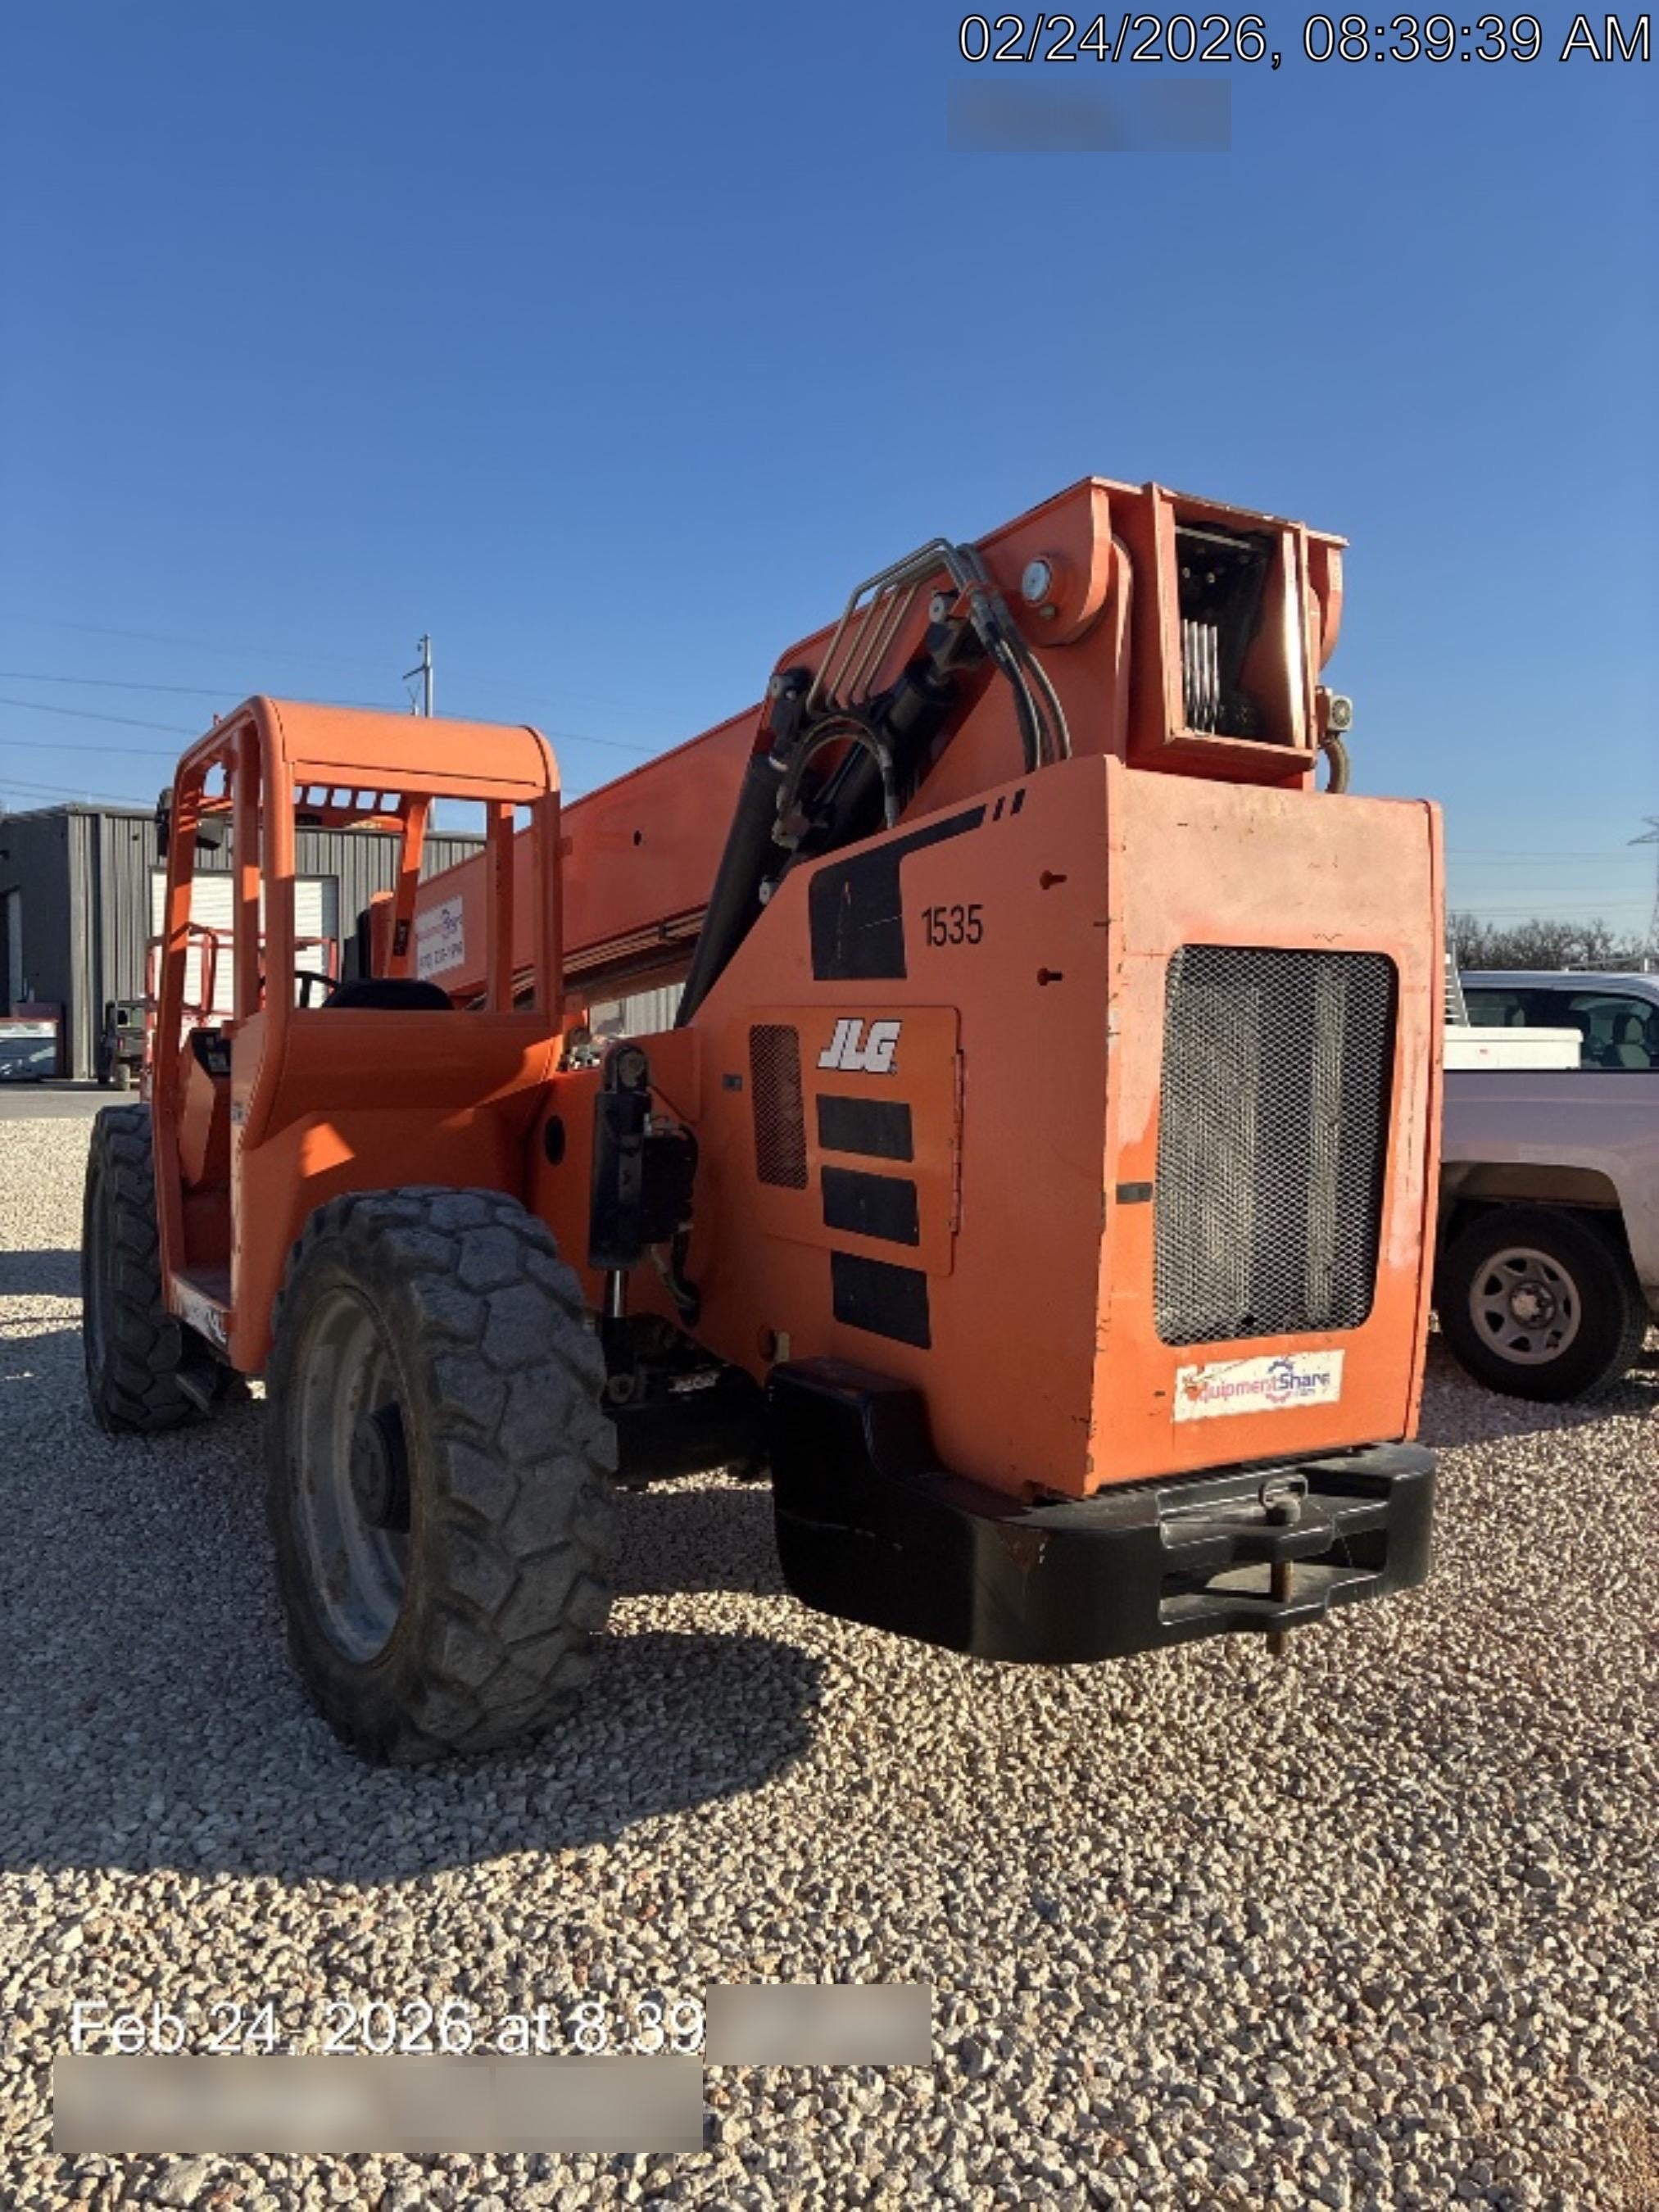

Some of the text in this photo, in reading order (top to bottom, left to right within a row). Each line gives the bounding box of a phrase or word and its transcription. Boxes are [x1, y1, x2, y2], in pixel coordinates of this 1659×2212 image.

[921, 904, 983, 946] 1535
[816, 1017, 903, 1074] JLG
[1184, 1372, 1330, 1403] quipmentShare
